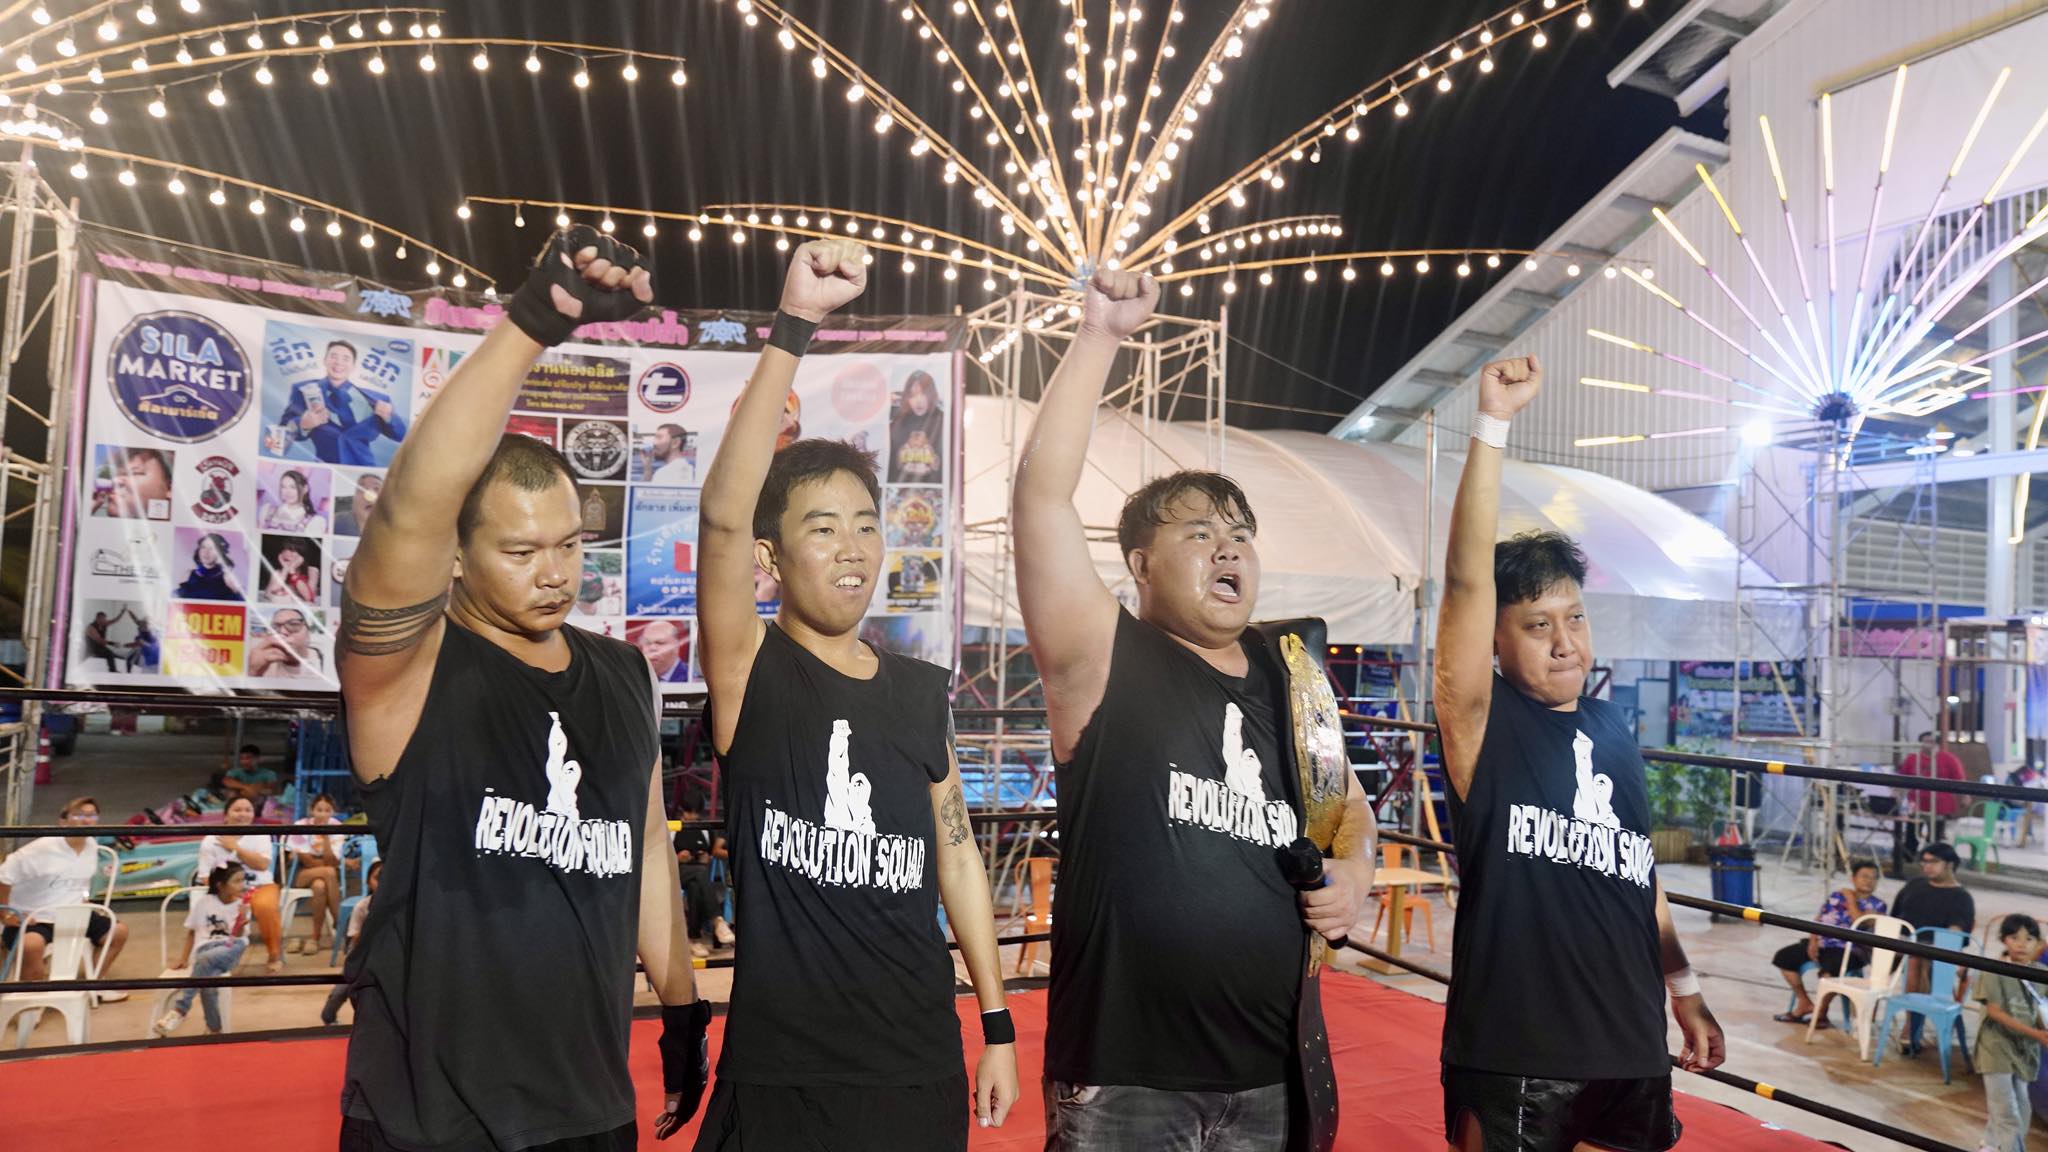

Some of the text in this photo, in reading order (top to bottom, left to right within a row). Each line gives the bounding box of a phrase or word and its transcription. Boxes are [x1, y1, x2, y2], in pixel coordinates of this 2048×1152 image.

[118, 354, 242, 392] MARKET
[140, 325, 223, 366] SILA
[475, 796, 584, 870] REVOLUTION
[1168, 771, 1271, 846] REVOLUTION
[1507, 804, 1618, 875] REVOLUTION
[761, 808, 925, 893] REVOLUTION SQUAD
